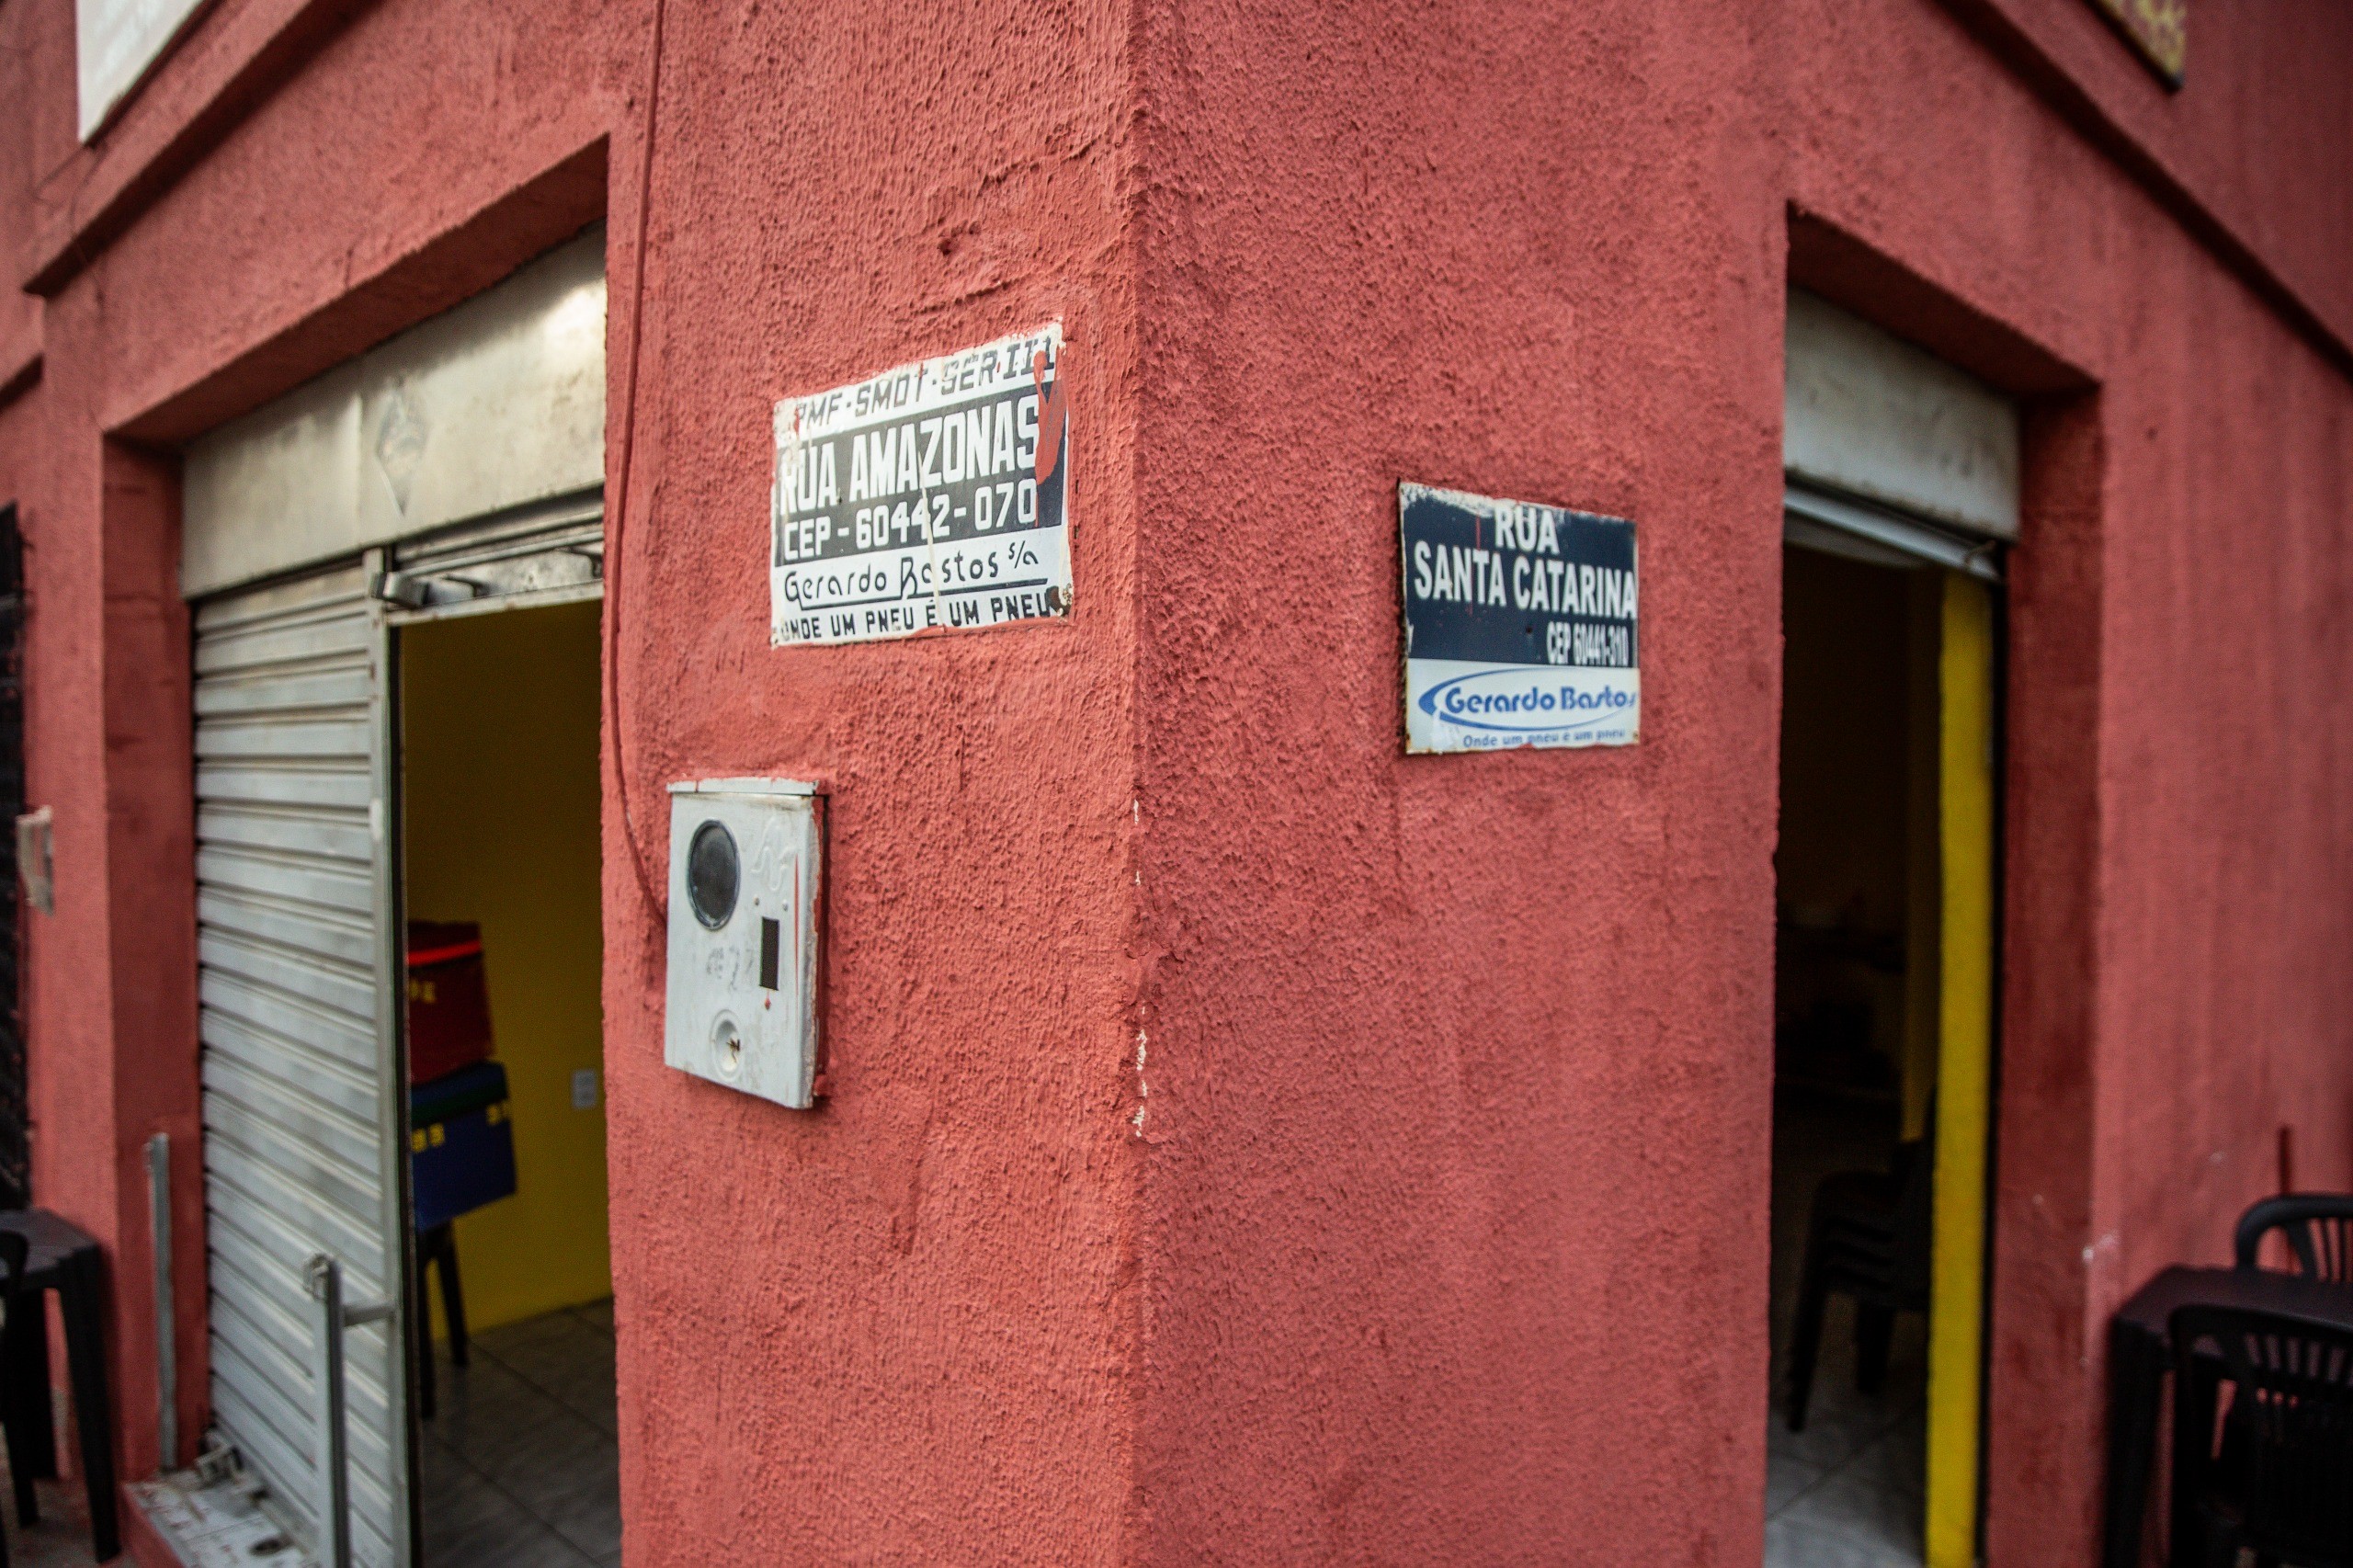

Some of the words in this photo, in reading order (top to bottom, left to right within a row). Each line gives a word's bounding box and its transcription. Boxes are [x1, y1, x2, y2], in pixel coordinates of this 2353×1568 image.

[779, 441, 838, 515] RUA
[848, 394, 1040, 503] AMAZONAS
[1494, 506, 1560, 555] RUA
[785, 563, 887, 603] Gerardo
[901, 551, 999, 599] Bastos
[1414, 540, 1507, 607] SANTA
[1513, 555, 1637, 619] CATARINA
[831, 613, 856, 636] UM
[866, 607, 914, 633] PNEU
[949, 599, 980, 627] UM
[1546, 621, 1571, 665] CEP
[1445, 687, 1555, 714] Gerardo
[1462, 734, 1498, 748] Onde
[1502, 735, 1523, 746] um
